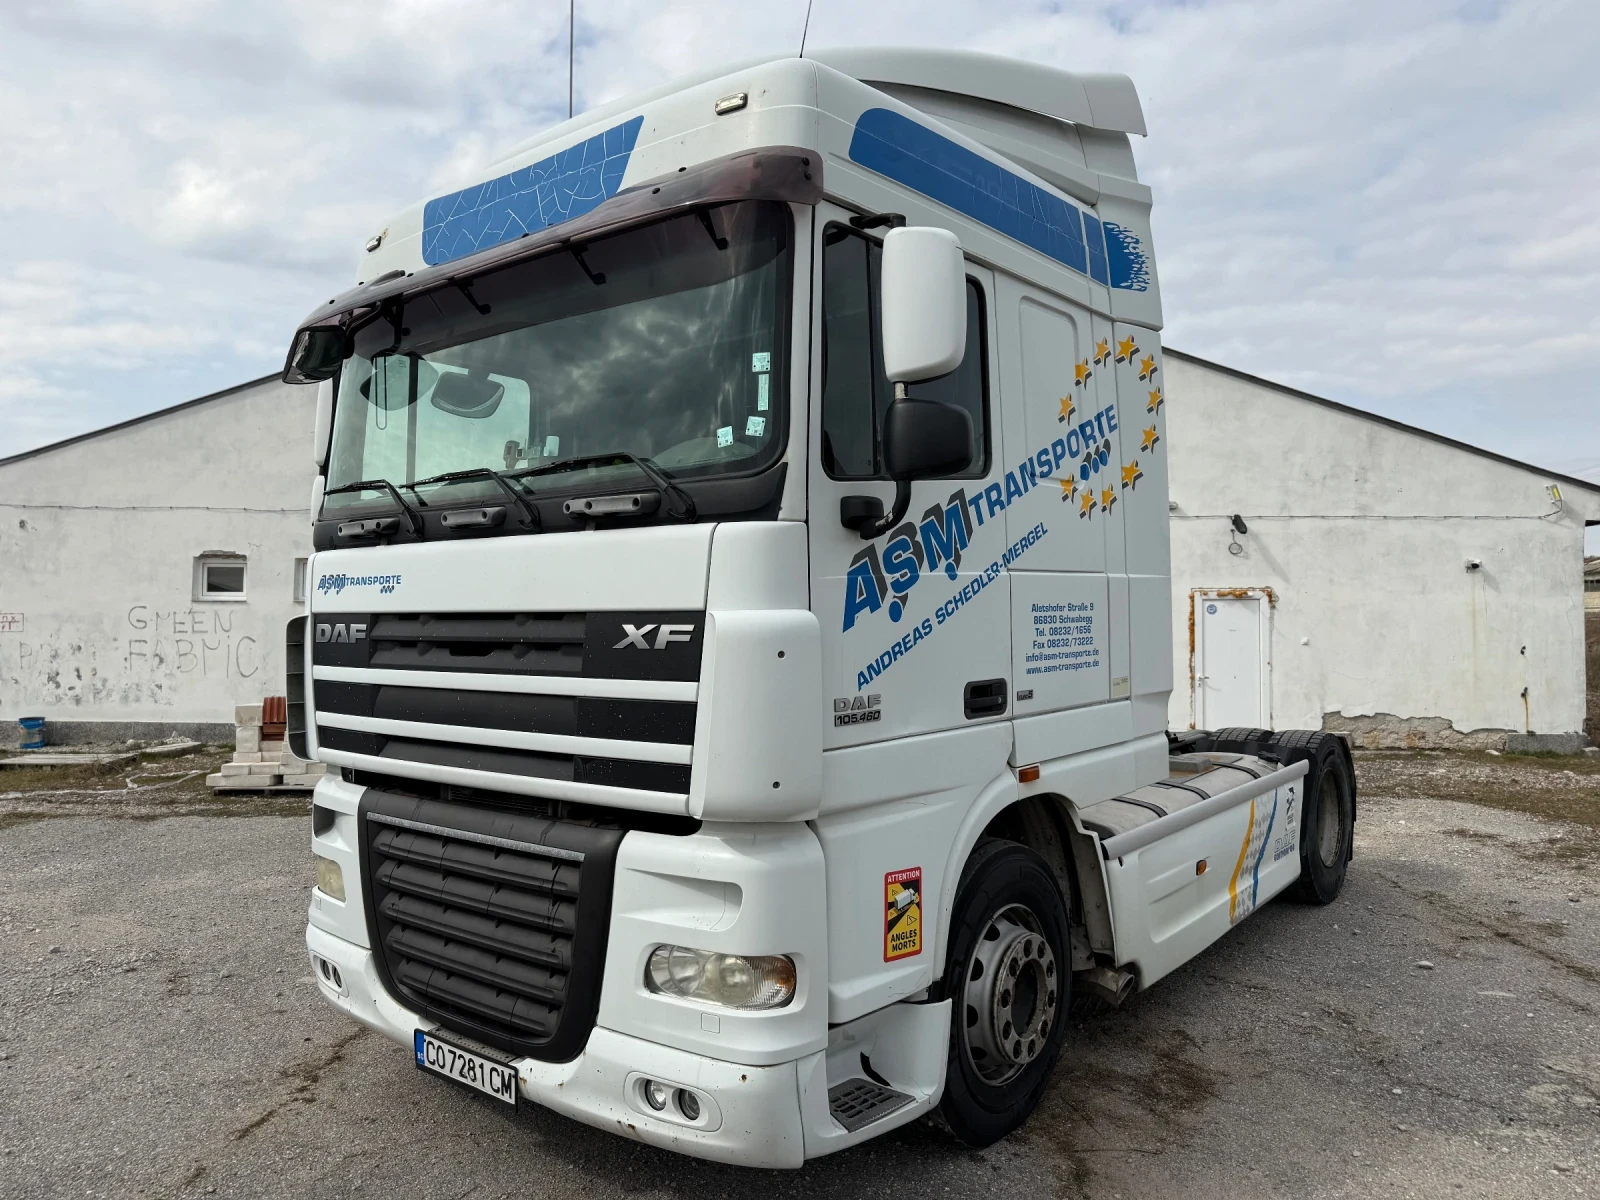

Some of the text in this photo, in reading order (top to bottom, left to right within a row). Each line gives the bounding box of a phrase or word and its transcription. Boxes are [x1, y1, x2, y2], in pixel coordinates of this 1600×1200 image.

[842, 404, 1118, 633] ASM TRANSPORTE
[345, 575, 402, 587] TRANSPORTE
[857, 521, 1048, 691] ANDREAS SCHEDLER-MERGEL
[1089, 602, 1094, 611] 9
[1033, 614, 1092, 625] 86830 Schwabegg
[315, 623, 367, 643] DAF
[612, 624, 696, 650] XF
[1035, 625, 1091, 637] Tel. 08232/1656
[1033, 636, 1094, 650] Fax 08232/73222
[1025, 648, 1099, 662] info@asm-transporte.de
[1026, 659, 1099, 675] www.asm-transporte.de
[834, 694, 881, 713] DAF
[836, 710, 881, 725] 105.460
[887, 869, 920, 883] ATTENTION
[890, 928, 917, 943] ANGLES
[891, 938, 916, 952] MORTS
